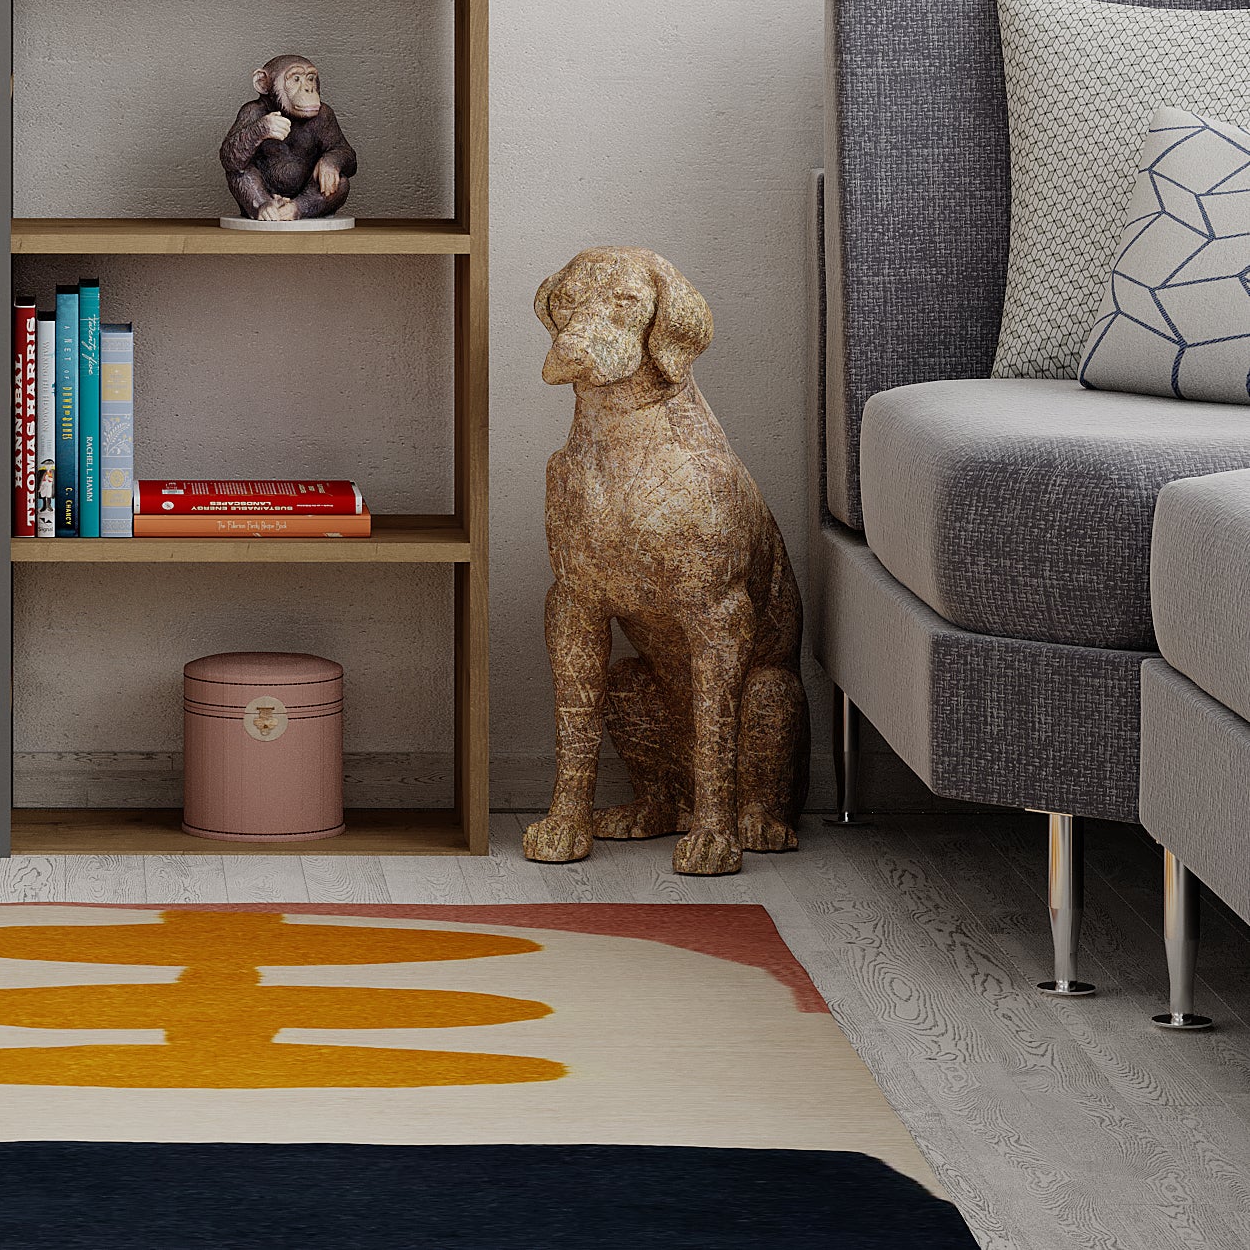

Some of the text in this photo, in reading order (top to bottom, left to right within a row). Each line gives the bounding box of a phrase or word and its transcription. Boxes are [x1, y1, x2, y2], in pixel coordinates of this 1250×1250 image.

[64, 339, 72, 361] NET
[82, 314, 97, 375] twenty-five
[64, 370, 69, 379] OF
[26, 317, 35, 526] THOMAS HARRIS
[217, 521, 225, 530] The
